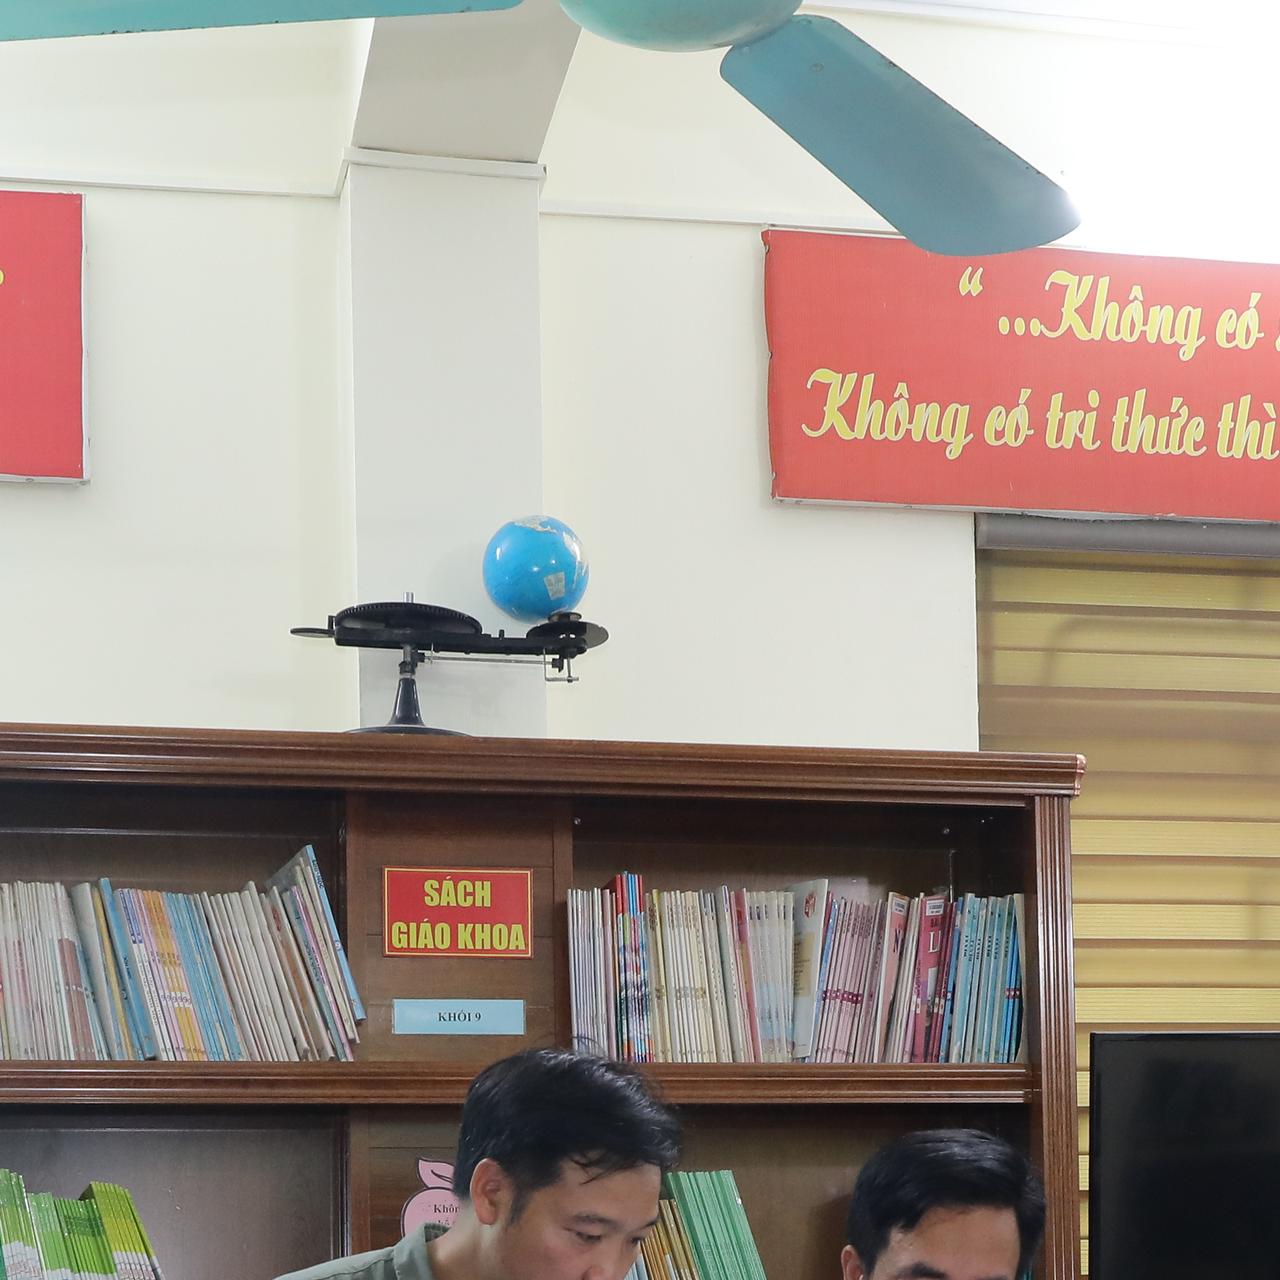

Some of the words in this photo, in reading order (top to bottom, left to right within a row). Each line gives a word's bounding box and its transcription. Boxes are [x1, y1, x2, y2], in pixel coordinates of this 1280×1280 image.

[1216, 292, 1265, 350] có
[802, 368, 973, 460] Không
[984, 388, 1034, 447] có
[1046, 390, 1101, 450] tri
[1112, 388, 1207, 456] thức
[1217, 394, 1279, 460] thì
[424, 875, 491, 907] SÁCH
[391, 918, 451, 949] GIÁO
[457, 923, 526, 950] KHOA
[475, 1012, 482, 1022] 9
